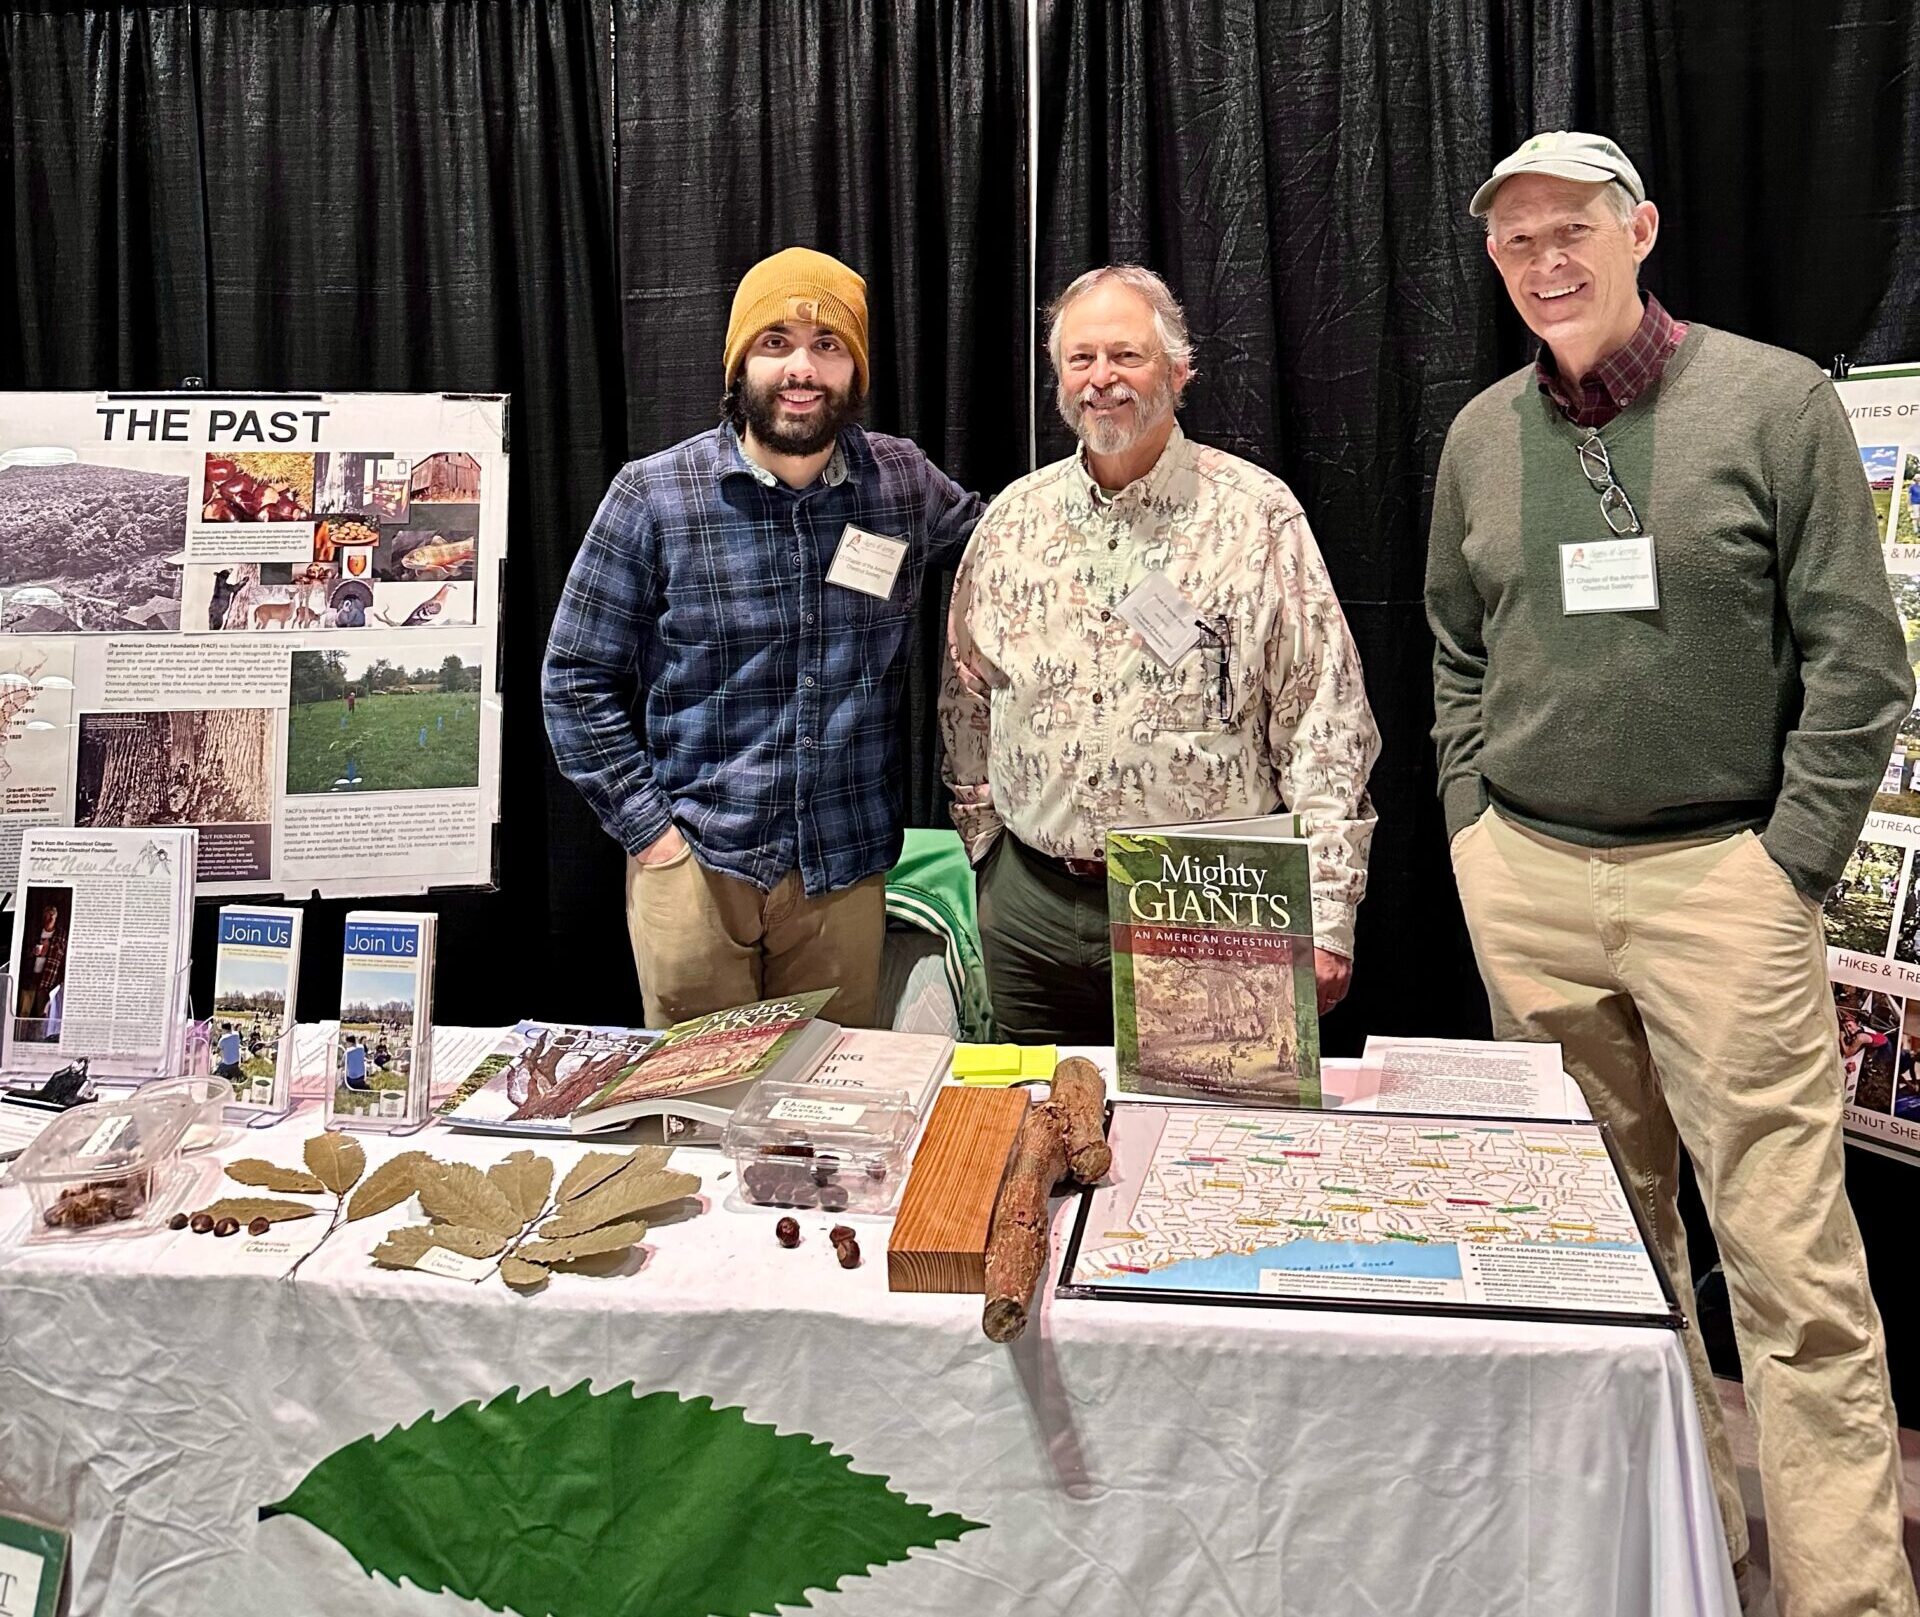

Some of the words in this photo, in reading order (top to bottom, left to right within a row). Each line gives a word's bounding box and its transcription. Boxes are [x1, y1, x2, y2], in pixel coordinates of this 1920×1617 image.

[1847, 405, 1892, 419] VITIES
[1897, 404, 1920, 417] OF
[96, 408, 190, 441] THE
[208, 409, 330, 443] PAST
[1890, 548, 1900, 559] &
[60, 854, 98, 873] New
[1160, 853, 1268, 898] Mighty
[1128, 880, 1291, 929] GIANTS
[224, 923, 261, 942] Join
[267, 925, 289, 944] Us
[348, 933, 385, 952] Join
[391, 935, 414, 953] Us
[1134, 930, 1151, 940] AN
[1155, 931, 1219, 944] AMERICAN
[1223, 936, 1289, 949] CHESTNUT
[1170, 946, 1252, 957] ANTHOLOGY
[1838, 954, 1878, 974] HIKES
[1882, 964, 1891, 977] &
[708, 1001, 798, 1024] Mighty
[830, 1053, 865, 1062] ING
[1843, 1109, 1886, 1130] STNUT
[1890, 1121, 1920, 1141] SHE
[1495, 1246, 1550, 1254] ORCHARDS
[1565, 1250, 1637, 1260] CONNECTICUT
